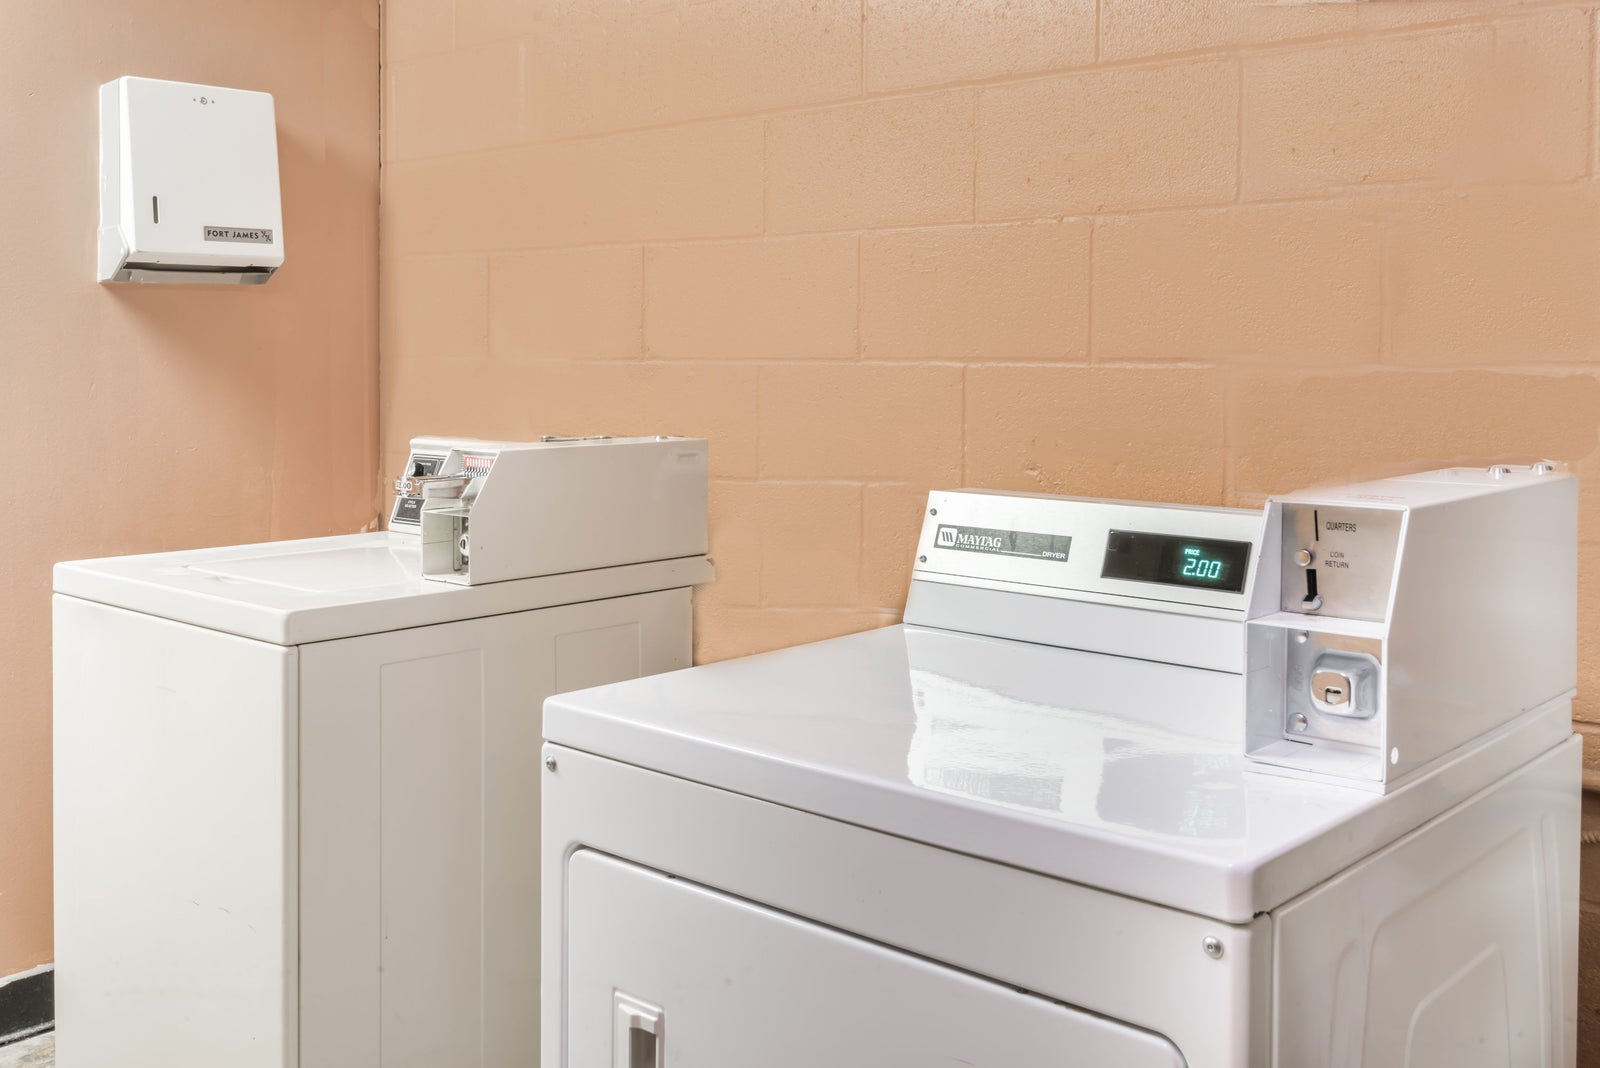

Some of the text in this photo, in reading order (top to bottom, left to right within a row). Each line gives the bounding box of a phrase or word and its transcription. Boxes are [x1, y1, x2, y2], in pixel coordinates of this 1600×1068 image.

[207, 229, 259, 240] FORT JAMES
[1326, 521, 1357, 532] QUARTERS
[956, 533, 1002, 548] MAYTAG
[955, 543, 1001, 553] COMMERCIAL
[1041, 550, 1067, 560] DRYER
[1329, 551, 1345, 559] COIN
[1183, 558, 1222, 579] 2.00
[1325, 560, 1349, 569] RETURN
